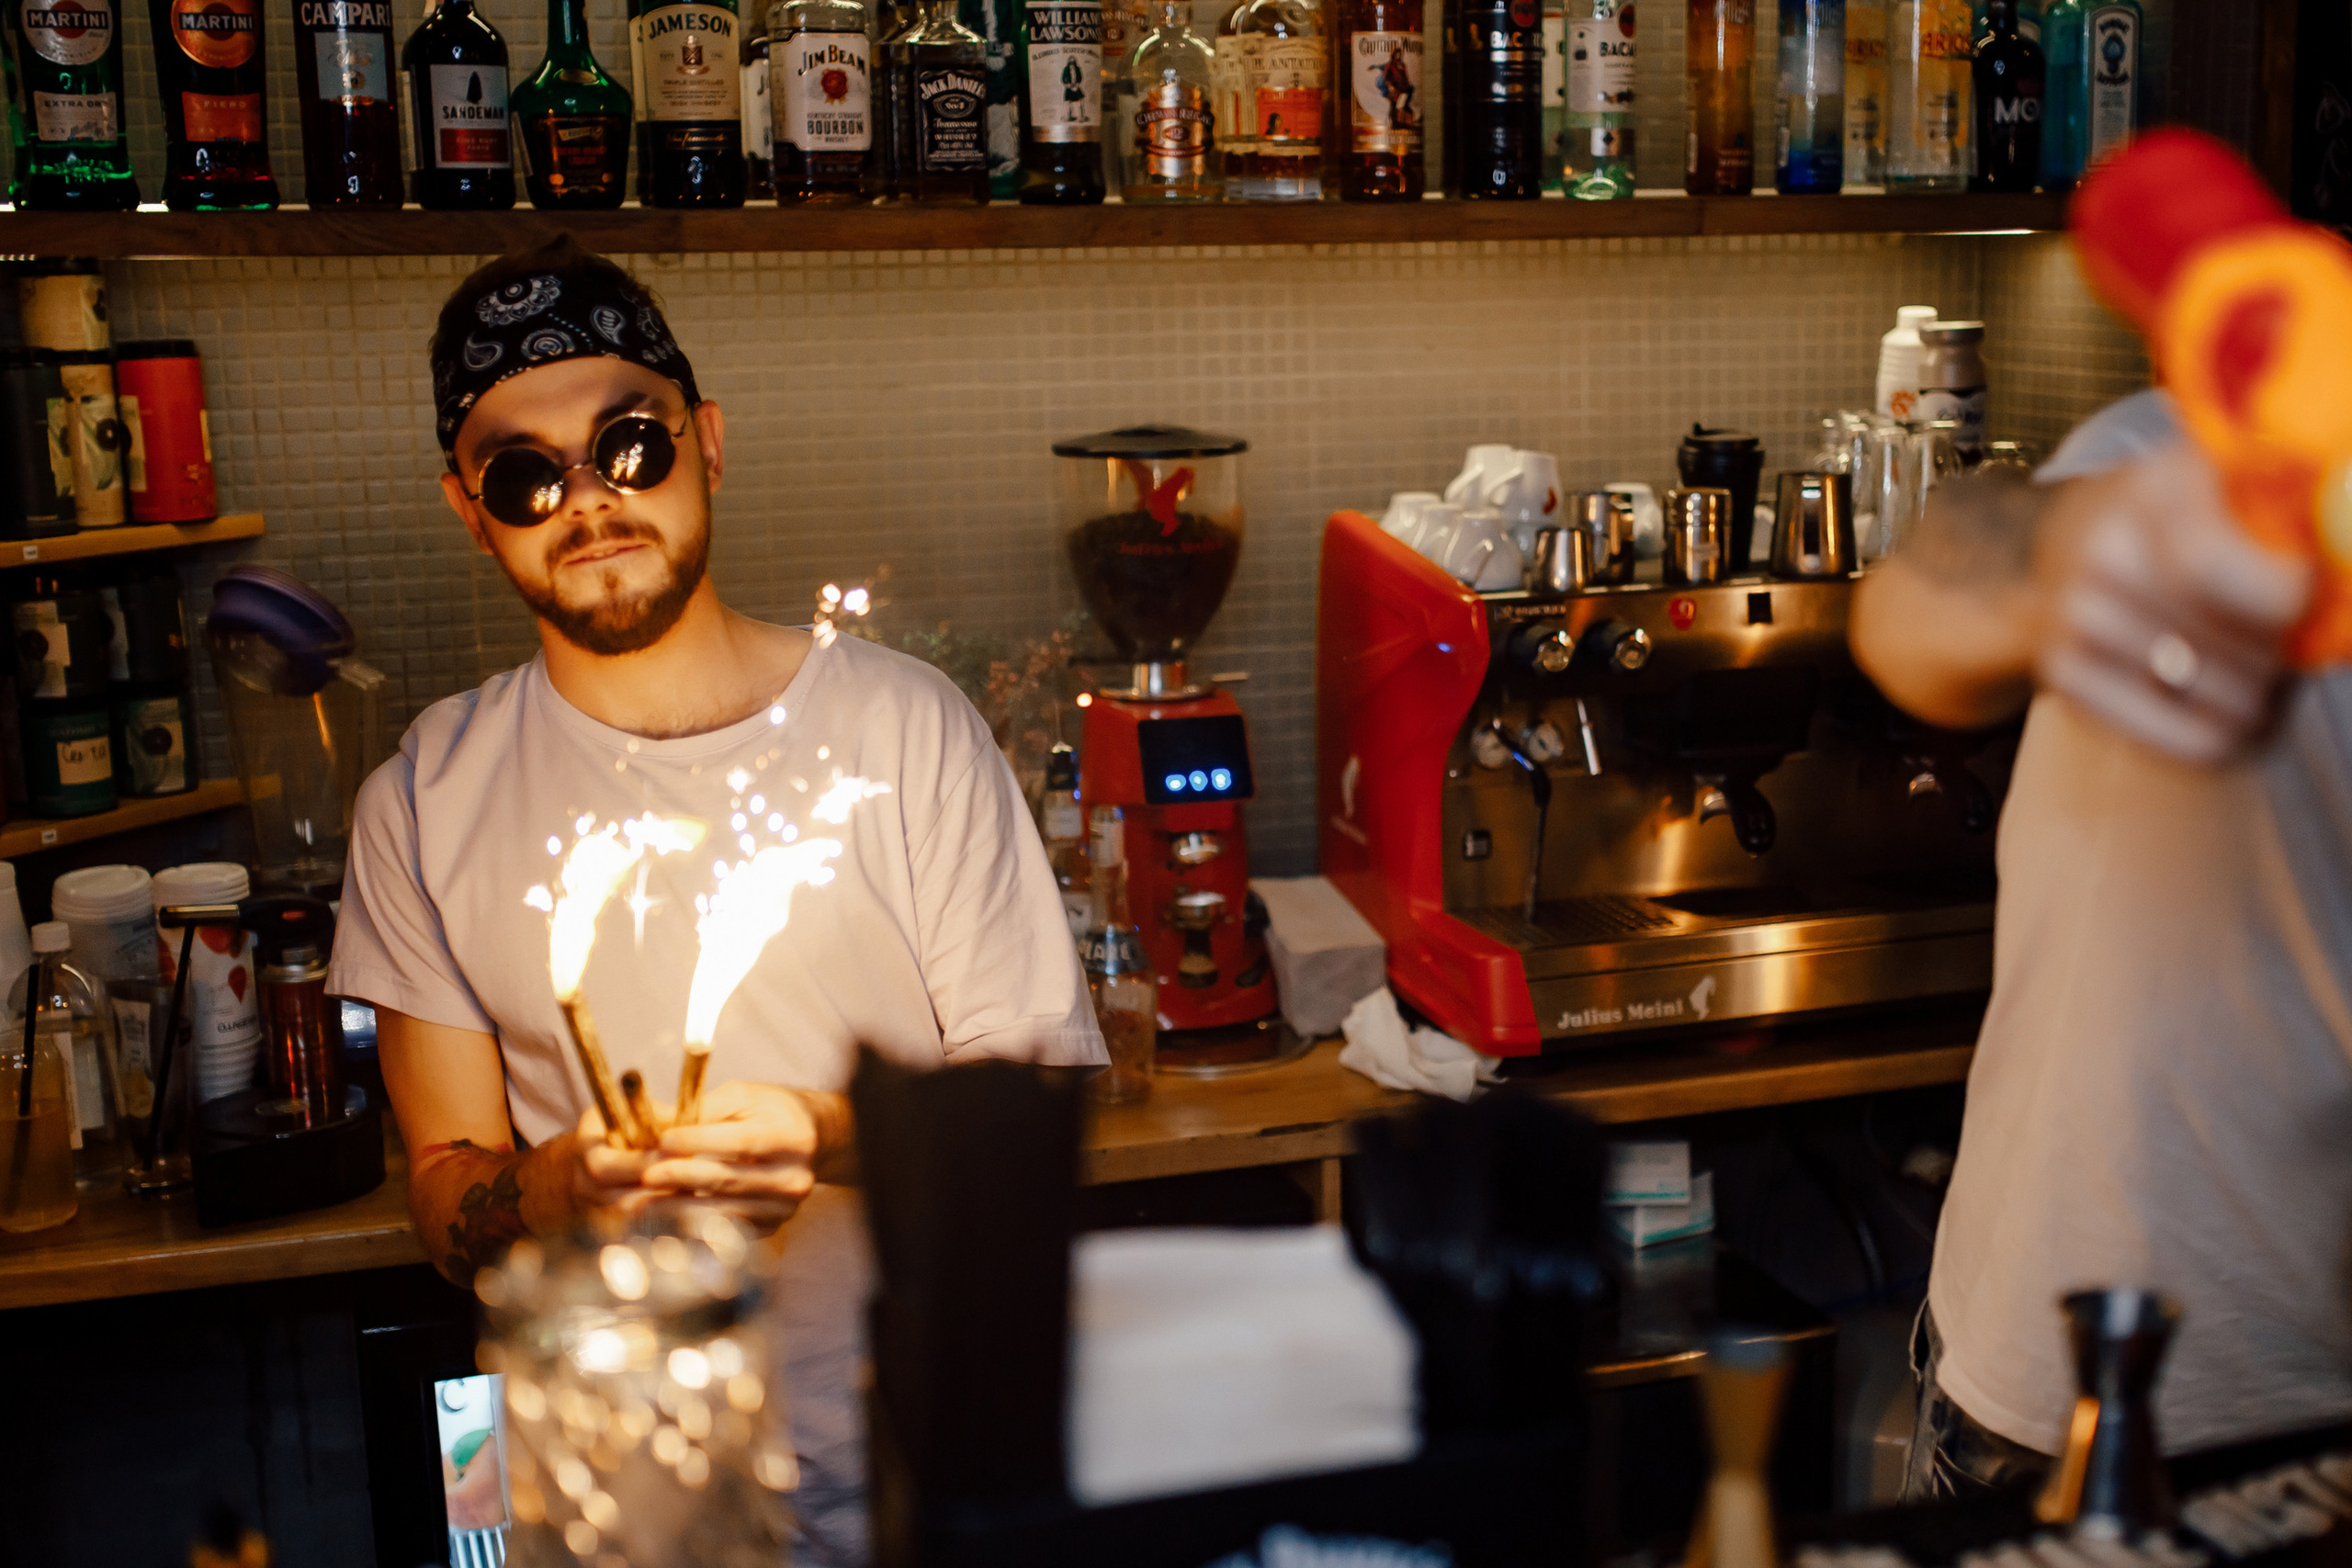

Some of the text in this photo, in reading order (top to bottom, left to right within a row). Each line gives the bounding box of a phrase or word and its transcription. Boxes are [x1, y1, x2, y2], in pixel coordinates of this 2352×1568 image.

[30, 12, 107, 28] MARTINI
[182, 15, 254, 30] MARTINI
[300, 2, 391, 28] CAMPARI
[649, 13, 733, 39] JAMESON
[798, 44, 866, 76] JIM BEAM
[44, 100, 83, 108] EXTRA
[442, 105, 504, 119] SANDEMAN
[807, 120, 865, 135] BOURBON
[1556, 1008, 1623, 1030] Julius
